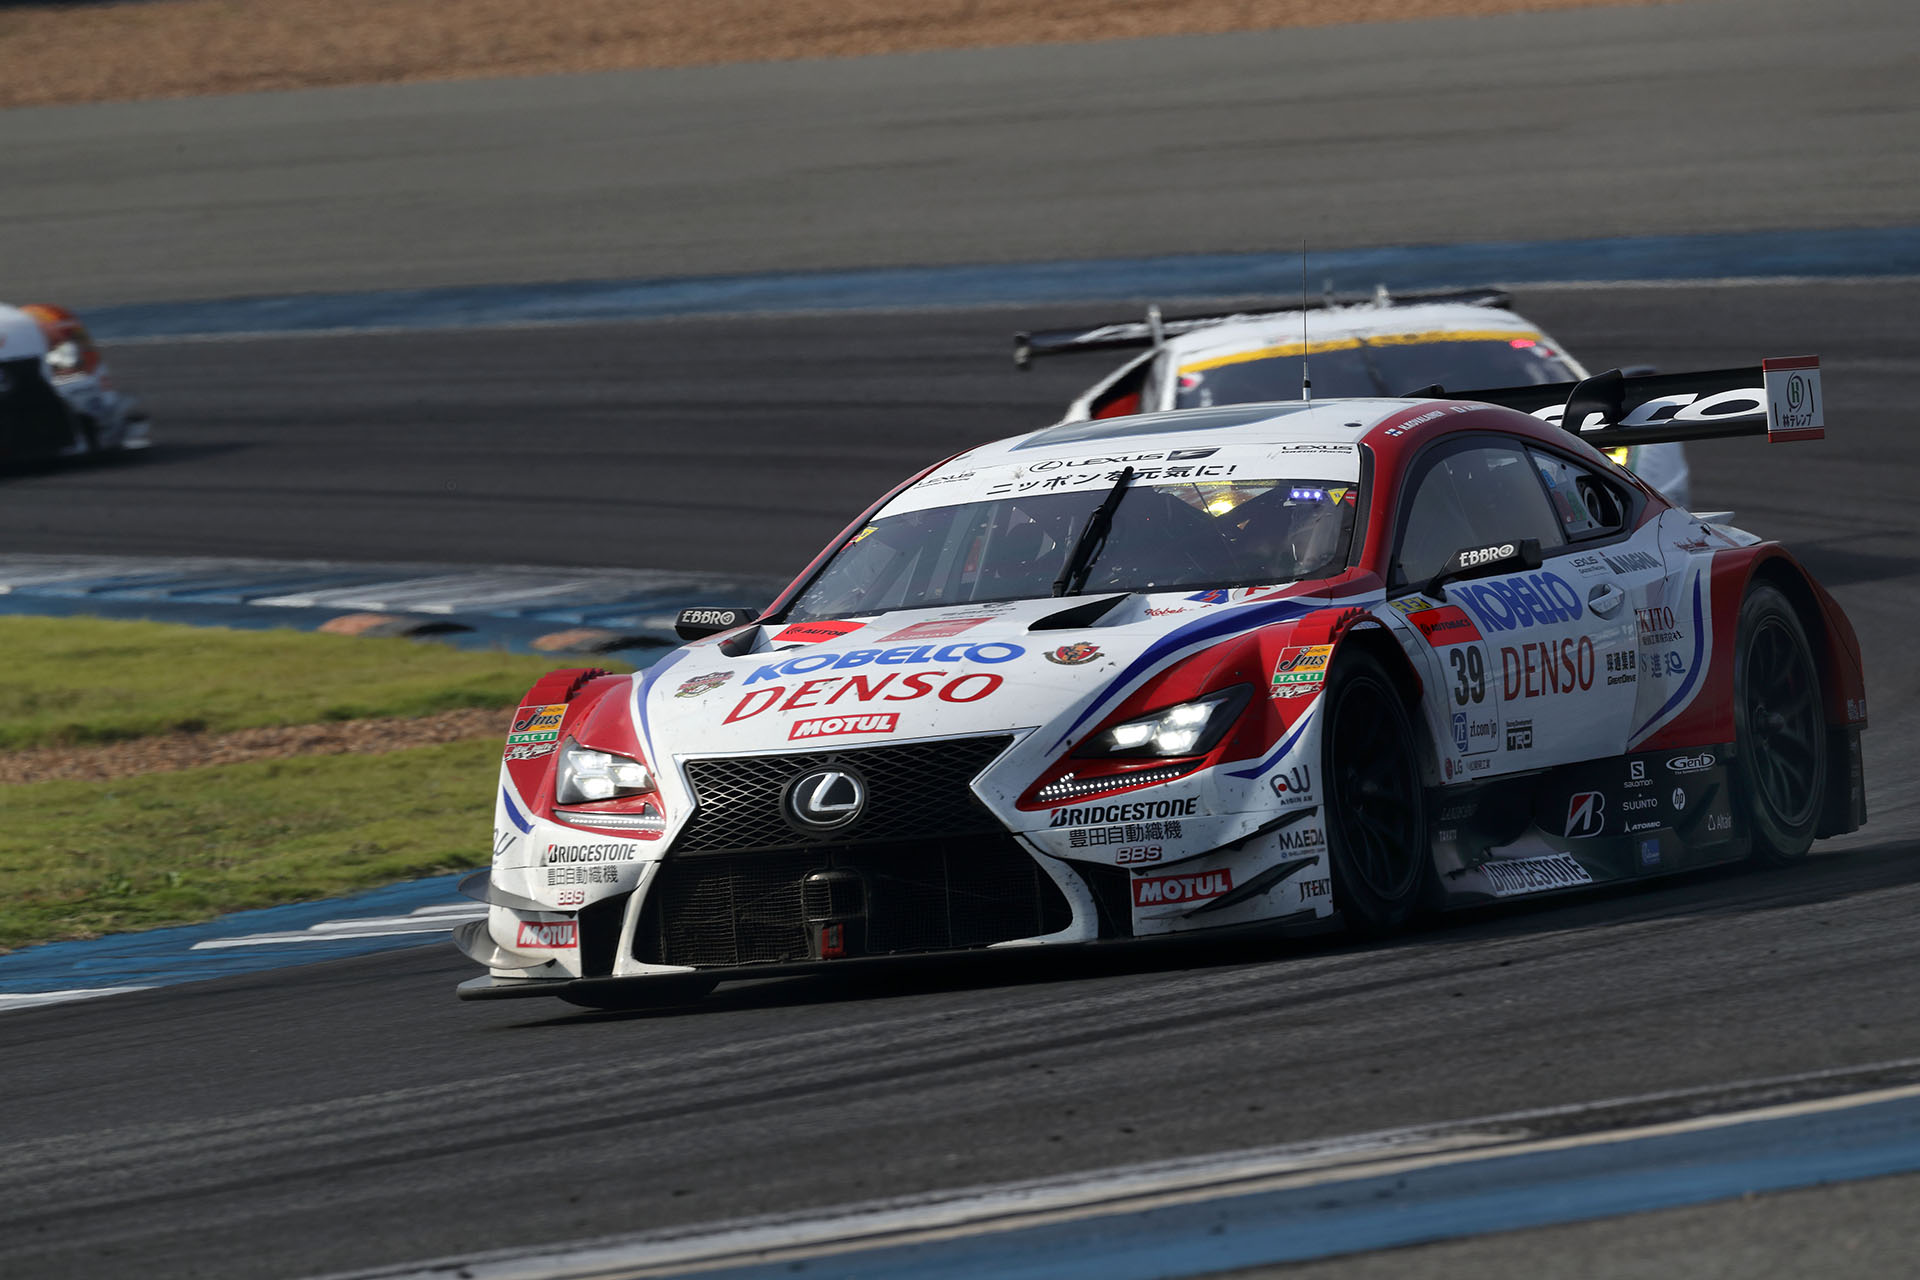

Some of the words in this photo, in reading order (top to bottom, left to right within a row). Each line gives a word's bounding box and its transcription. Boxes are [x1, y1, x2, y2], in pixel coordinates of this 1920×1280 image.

[1066, 452, 1164, 467] LEXUS
[1459, 544, 1514, 567] EBBRO
[1451, 571, 1583, 633] KOBELCO
[682, 610, 735, 625] EBBRO
[1637, 606, 1675, 633] KITO
[743, 642, 1026, 686] KOBELCO
[1501, 636, 1595, 702] DENSO
[1278, 673, 1318, 683] TACTI
[1450, 645, 1486, 706] 39
[722, 671, 1004, 725] DENSO
[514, 733, 553, 743] TACTI
[802, 717, 892, 738] MOTUL
[1050, 796, 1199, 827] BRIDGESTONE
[1623, 798, 1658, 811] SUUNTO
[1069, 820, 1183, 848] 豊田自動織機
[1632, 821, 1661, 831] ATOMIC
[1279, 828, 1325, 850] MAEDA
[548, 844, 638, 863] BRIDGESTONE
[1115, 846, 1162, 864] BBS
[547, 865, 619, 886] 豊田自動織機
[1480, 854, 1590, 893] BRIDGESTONE
[558, 890, 585, 906] BBS
[1139, 873, 1229, 903] MOTUL
[1300, 879, 1330, 902] JTEKT
[519, 925, 575, 945] MOTUL
